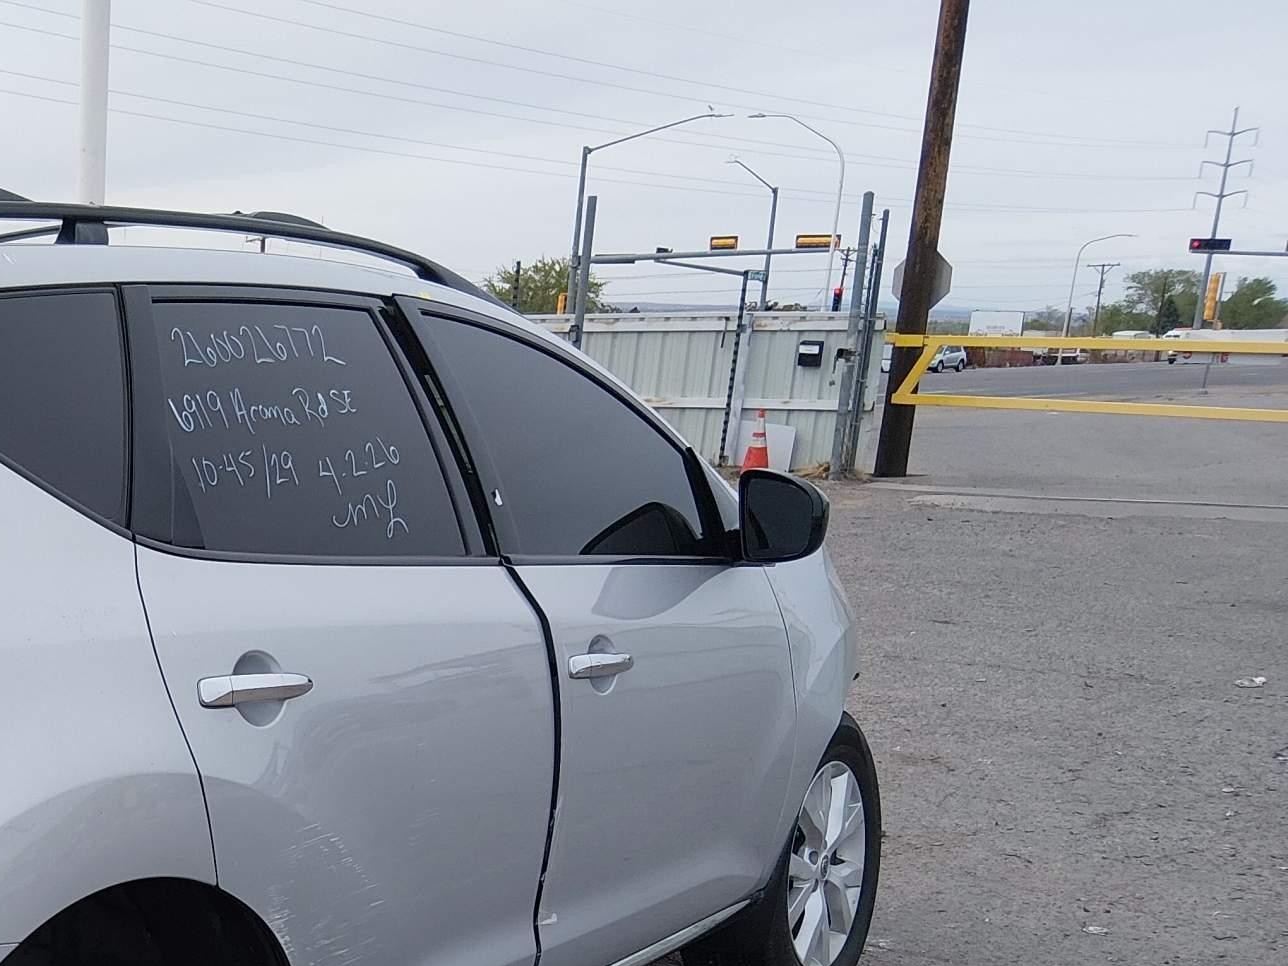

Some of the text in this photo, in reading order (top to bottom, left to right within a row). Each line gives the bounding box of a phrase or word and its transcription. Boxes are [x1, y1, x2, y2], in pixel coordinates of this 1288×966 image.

[170, 324, 347, 368] 260026772
[168, 389, 229, 433] 6919
[291, 386, 329, 428] Rd
[329, 389, 358, 414] SE
